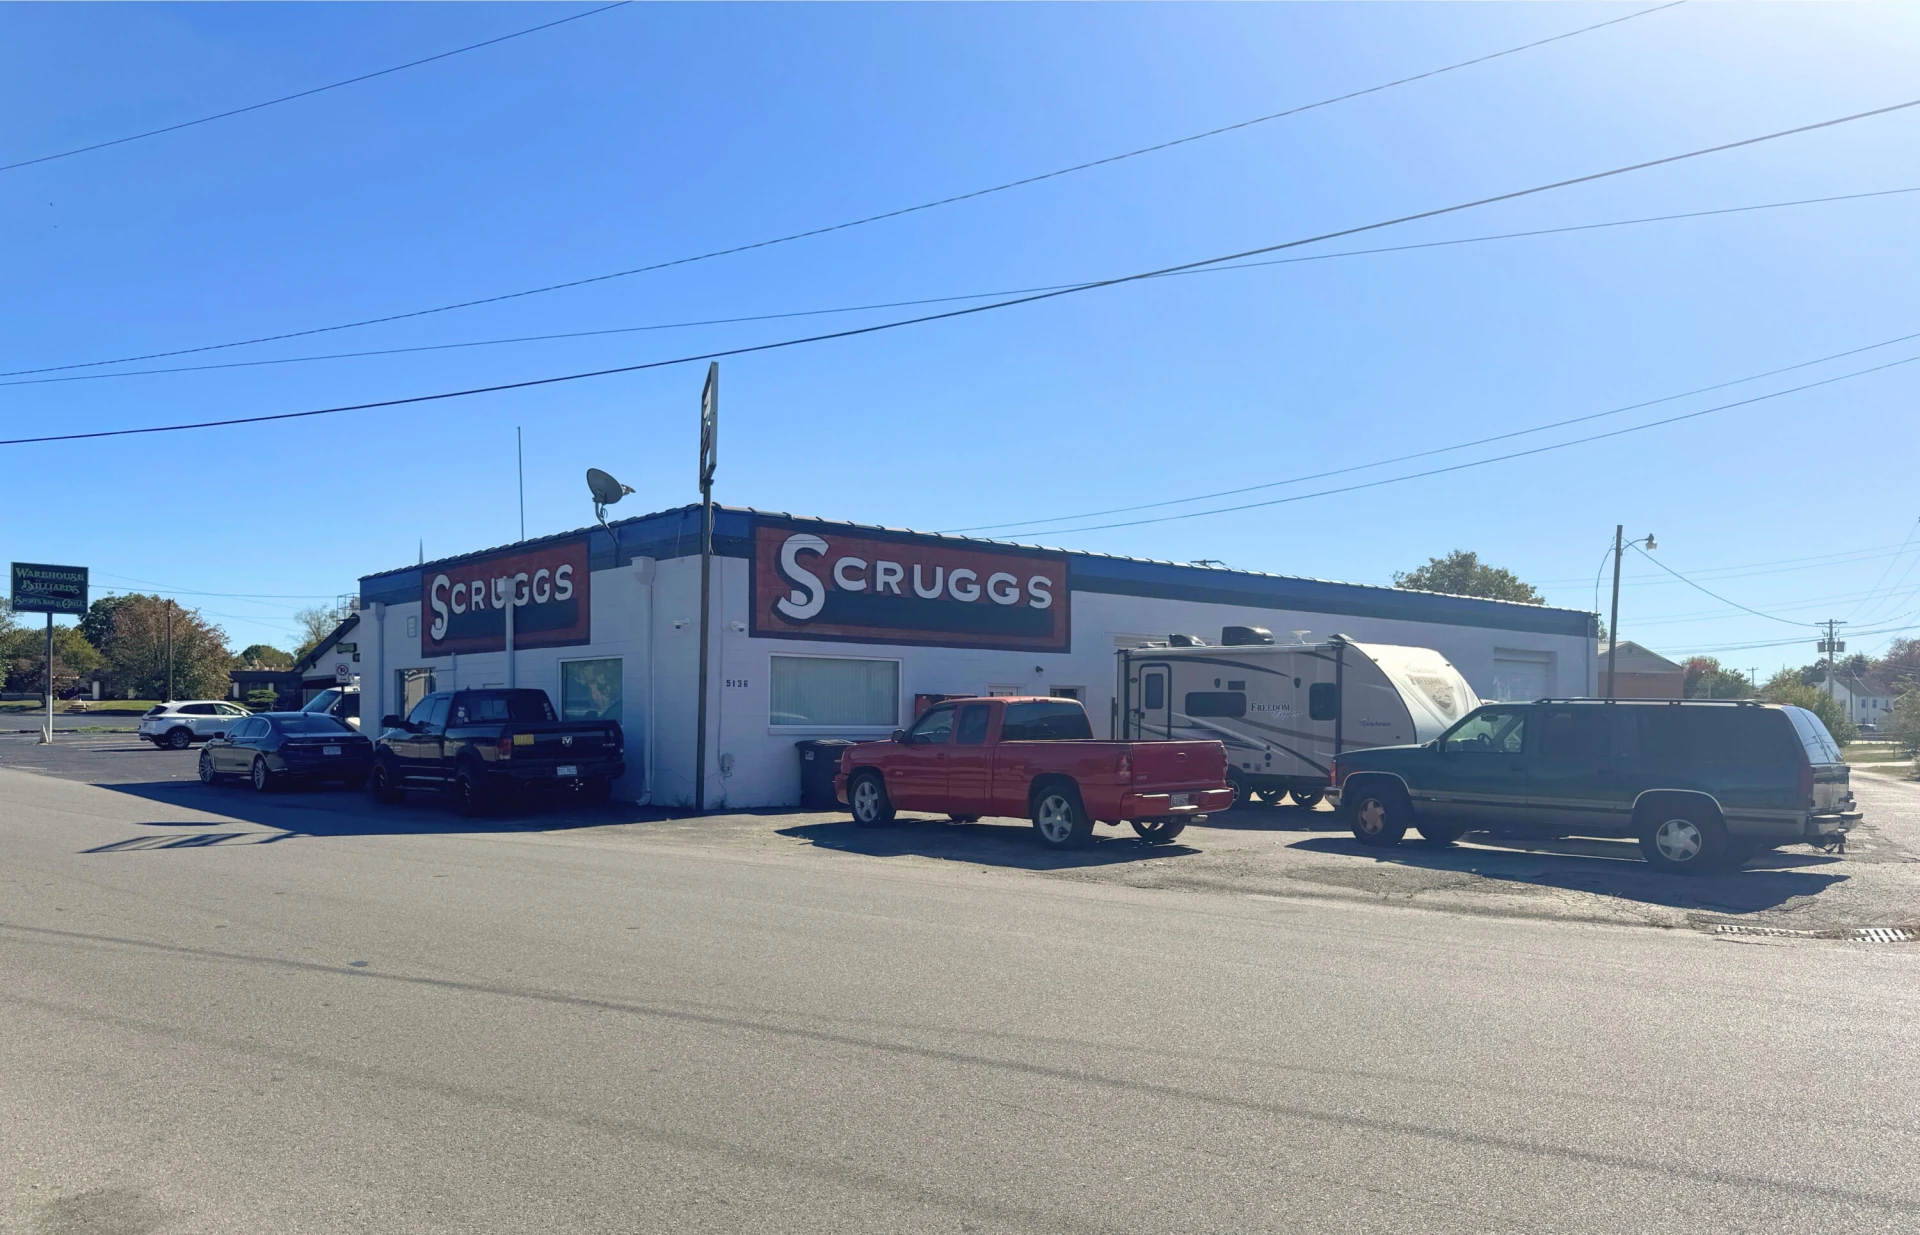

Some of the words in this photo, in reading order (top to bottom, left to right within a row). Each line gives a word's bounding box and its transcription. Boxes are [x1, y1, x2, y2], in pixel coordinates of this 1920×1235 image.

[15, 568, 84, 581] WAREHOUSE
[777, 533, 1053, 620] SCRUGGS
[21, 580, 79, 594] BILLIARDS
[726, 679, 749, 688] 5136
[1251, 702, 1290, 711] FREEDOM
